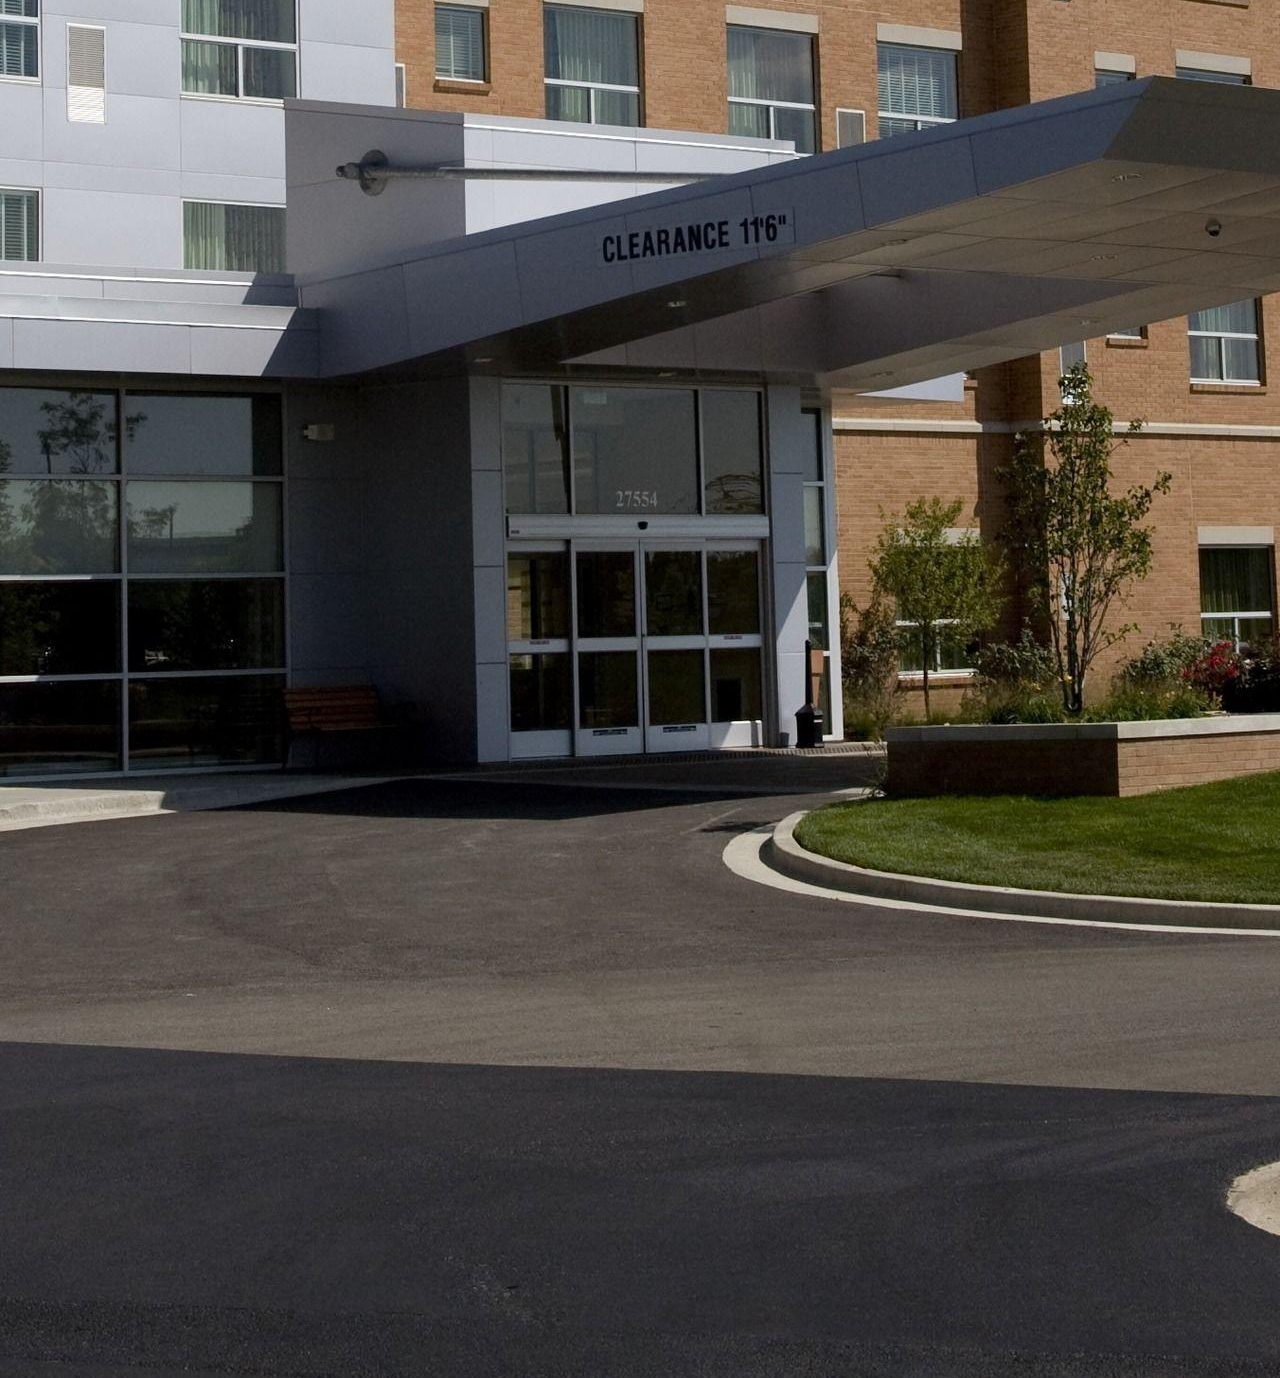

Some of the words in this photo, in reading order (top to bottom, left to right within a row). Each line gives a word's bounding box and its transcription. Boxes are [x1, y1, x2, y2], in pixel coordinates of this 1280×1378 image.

[602, 220, 730, 263] CLEARANCE
[739, 214, 787, 244] 11'6"
[615, 490, 658, 508] 27554
